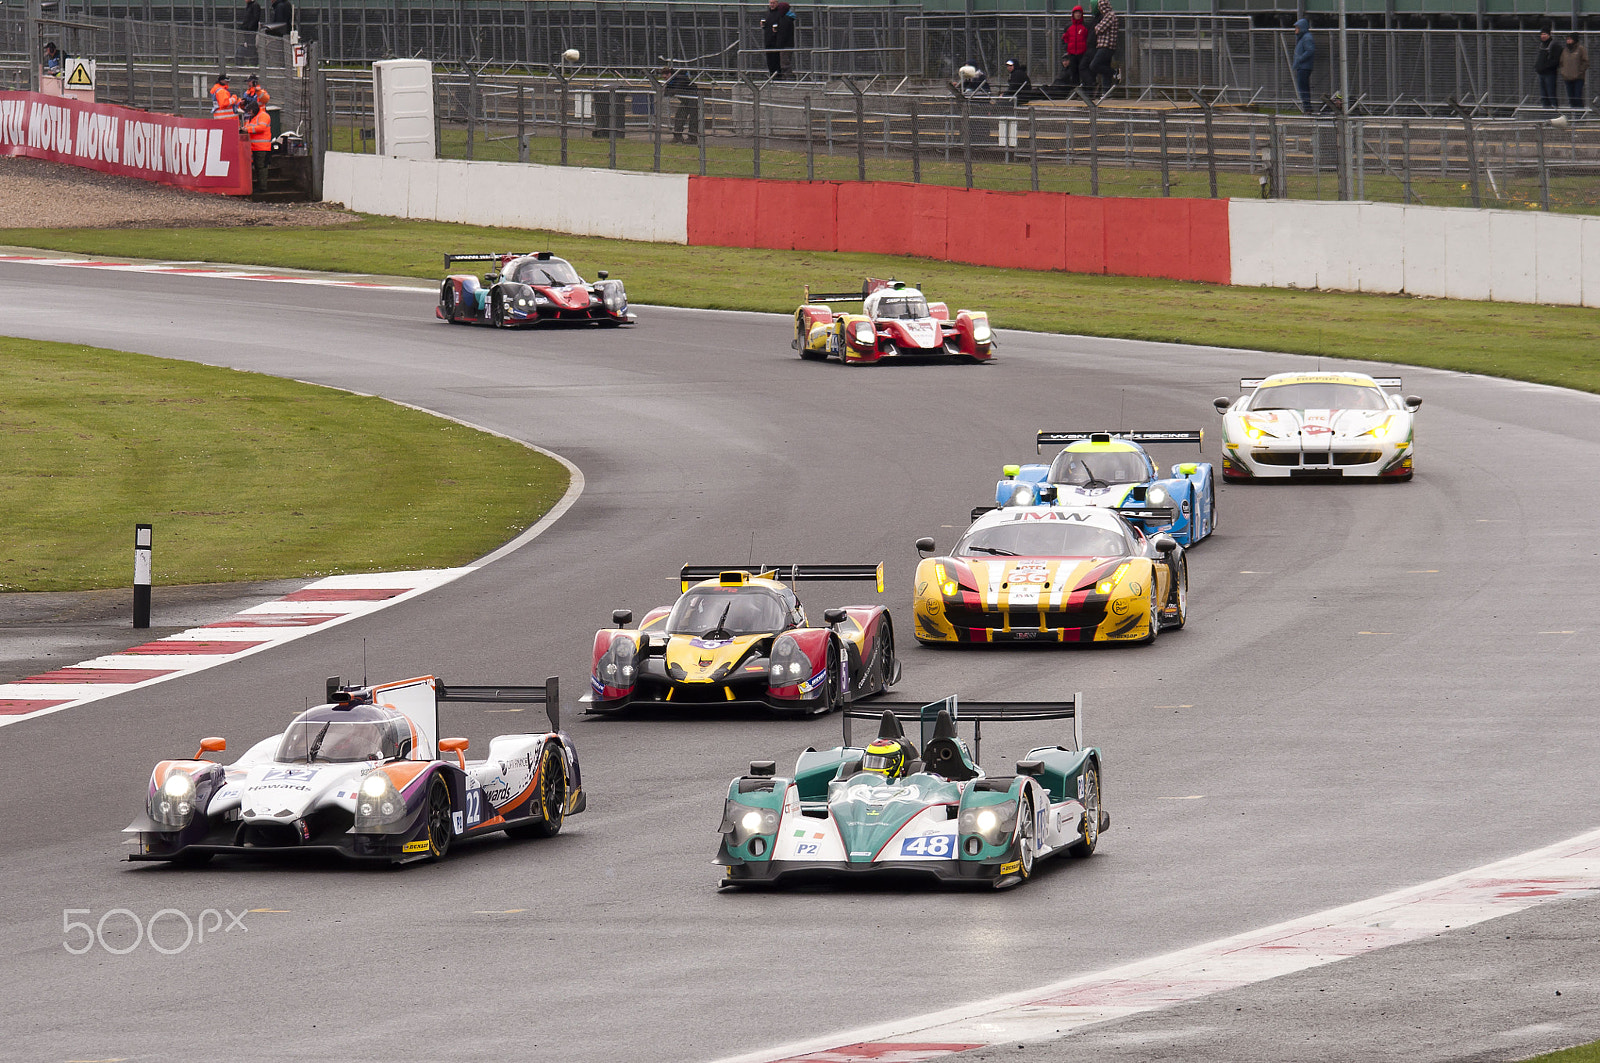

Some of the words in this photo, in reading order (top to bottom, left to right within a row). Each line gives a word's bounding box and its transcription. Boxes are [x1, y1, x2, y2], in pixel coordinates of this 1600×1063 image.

[0, 100, 25, 146] TUL
[28, 102, 72, 155] MOTUL
[75, 110, 120, 163] MOTUL
[123, 119, 163, 171] MOTUL
[164, 126, 230, 177] MOTUL
[1013, 511, 1092, 522] JMW
[1008, 573, 1047, 583] 66
[248, 784, 312, 792] Howards
[466, 791, 480, 824] 22
[797, 844, 818, 854] P2
[906, 836, 950, 856] 48
